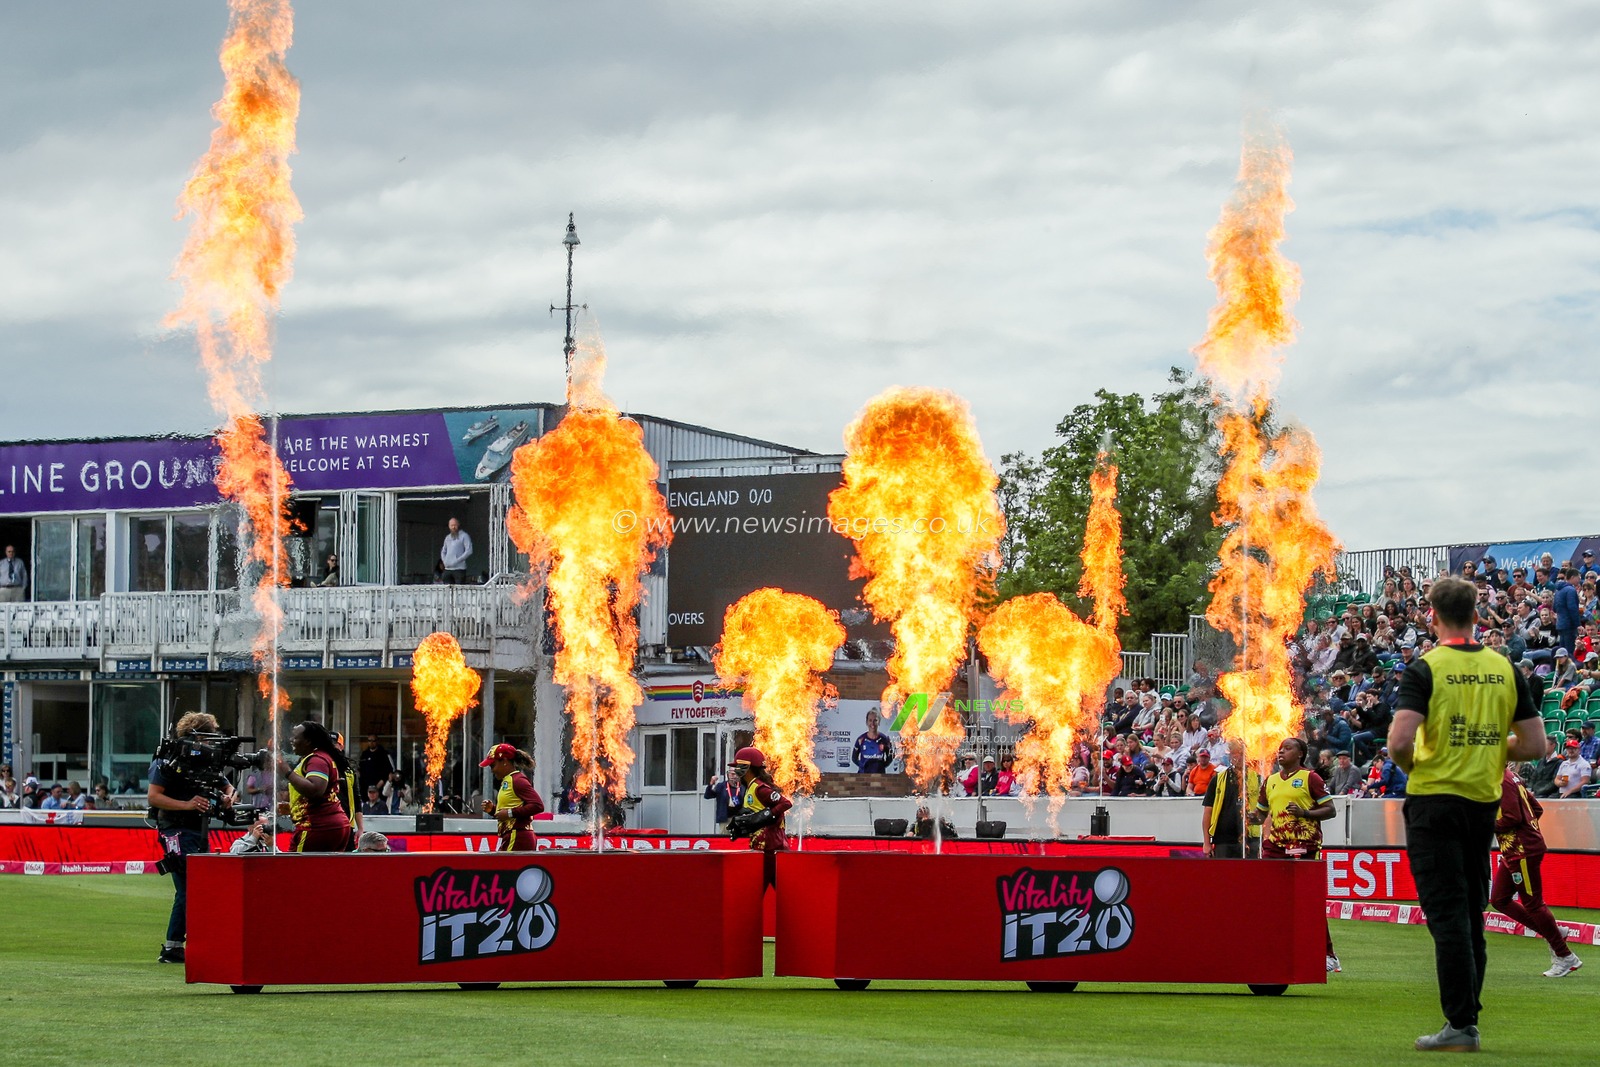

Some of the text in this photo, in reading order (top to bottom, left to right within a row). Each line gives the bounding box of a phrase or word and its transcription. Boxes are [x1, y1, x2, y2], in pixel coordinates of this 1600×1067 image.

[320, 436, 348, 451] THE
[355, 433, 430, 449] WARMEST
[356, 456, 374, 470] AT
[382, 455, 411, 470] SEA
[669, 488, 773, 507] ENGLAND 0/0
[1500, 558, 1517, 571] We
[668, 612, 705, 625] OVERS
[1446, 674, 1505, 685] SUPPLIER
[671, 708, 684, 719] FLY
[61, 864, 81, 873] Health
[83, 864, 110, 873] insurance
[1320, 852, 1400, 897] EST
[420, 870, 515, 918] Vitality
[1003, 871, 1093, 918] Vitality
